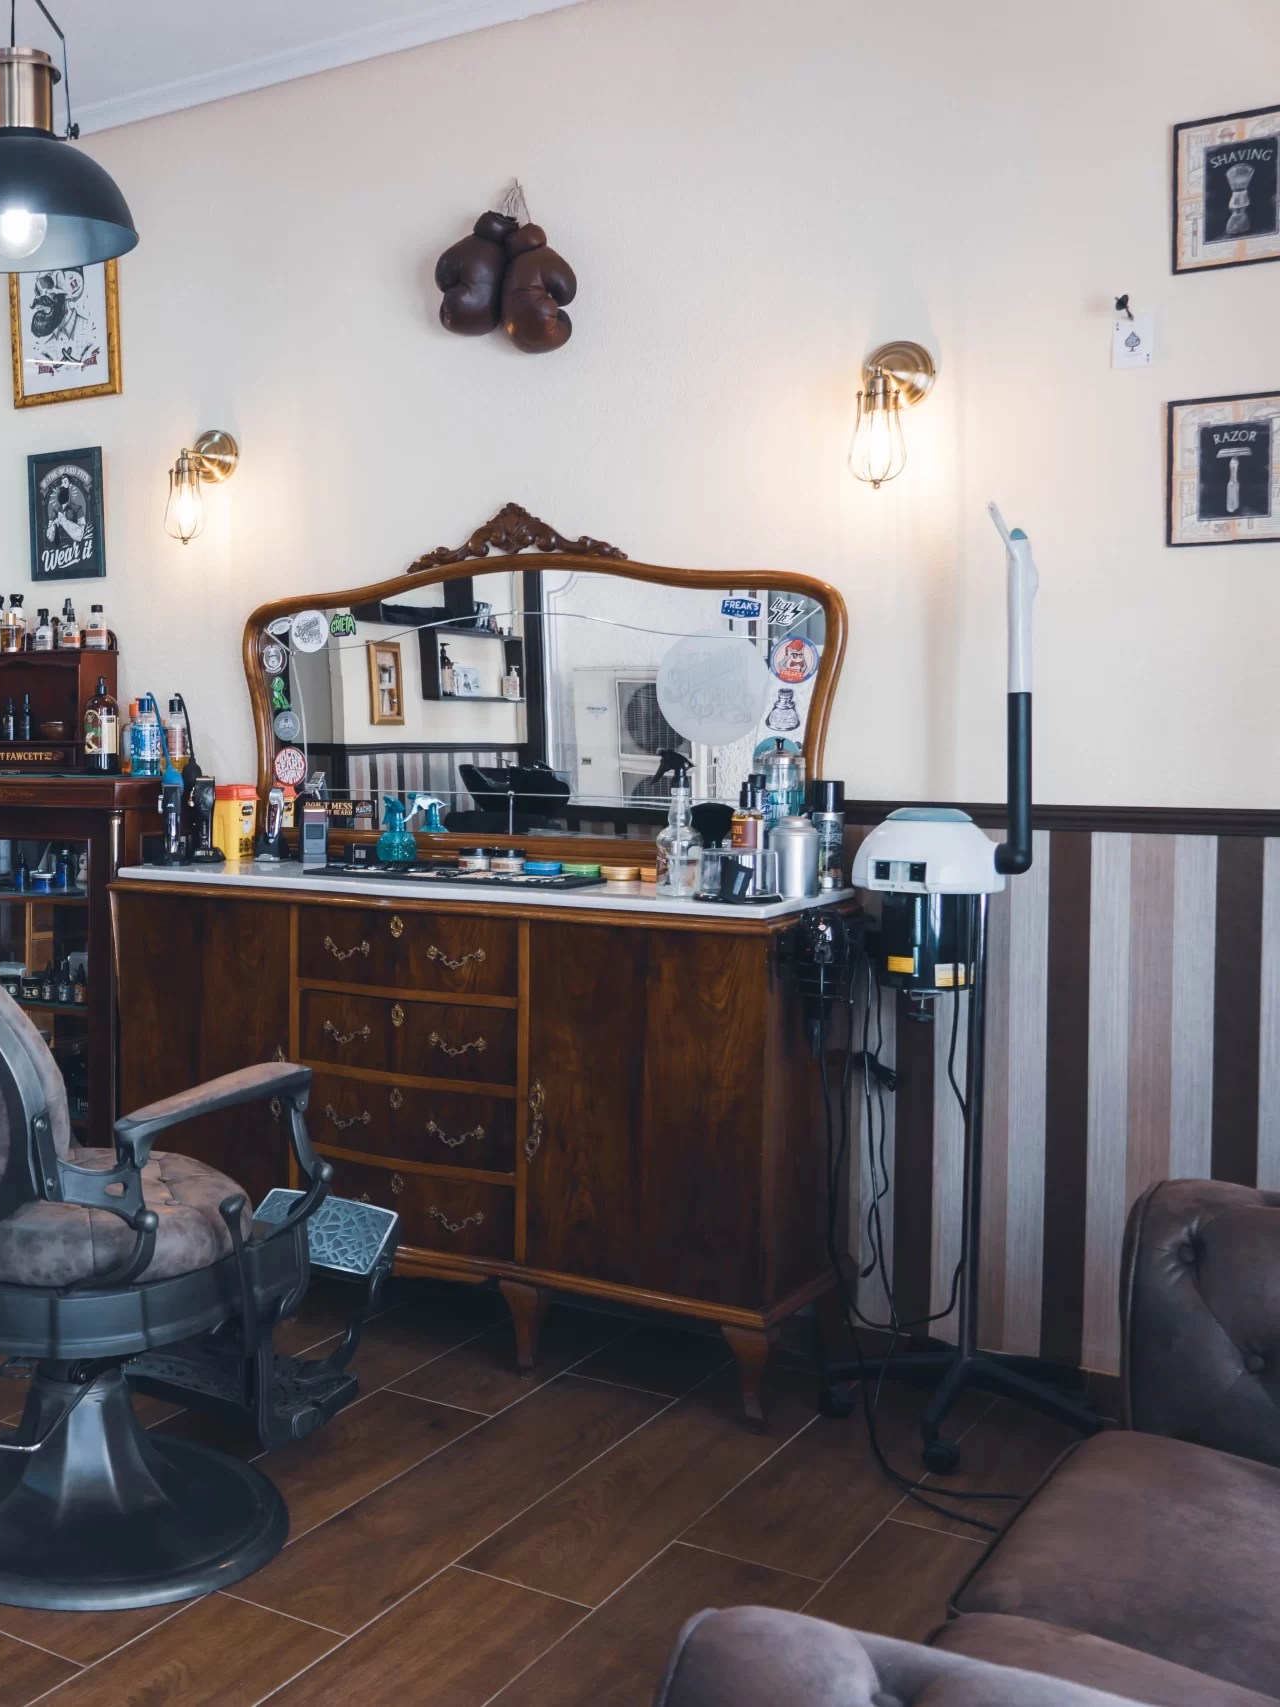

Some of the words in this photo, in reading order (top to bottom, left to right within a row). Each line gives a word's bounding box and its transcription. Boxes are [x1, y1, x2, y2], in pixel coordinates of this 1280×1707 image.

[1210, 148, 1273, 169] SHAVING
[1212, 430, 1258, 445] RAZOR
[41, 541, 81, 572] Wear
[82, 539, 93, 560] it
[724, 600, 759, 611] FREAK'S
[6, 751, 44, 761] FAWCETT
[276, 759, 305, 775] BEARD
[331, 802, 353, 810] MESS
